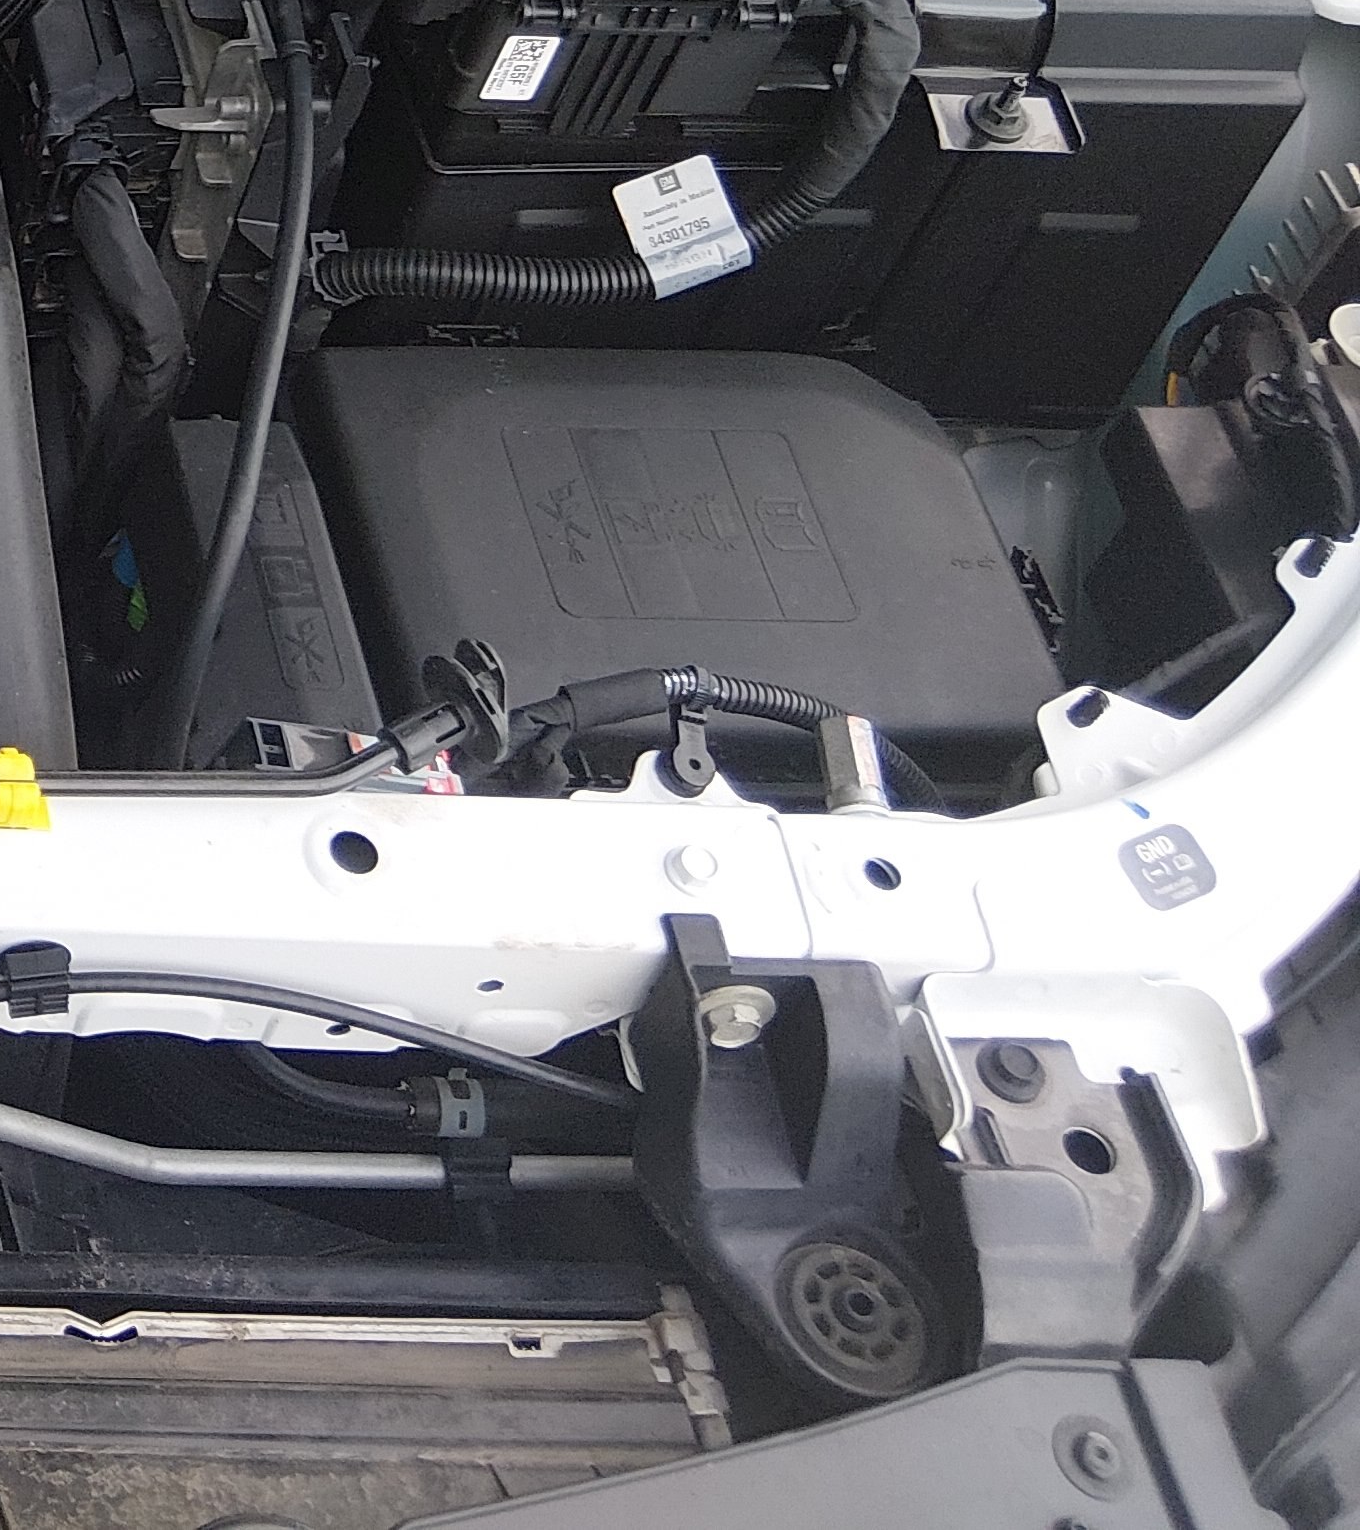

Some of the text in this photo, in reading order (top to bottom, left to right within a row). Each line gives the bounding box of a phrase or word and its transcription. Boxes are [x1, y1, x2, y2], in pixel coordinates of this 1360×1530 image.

[506, 64, 530, 86] G5F
[648, 216, 712, 249] 84301795
[1135, 835, 1176, 864] GND
